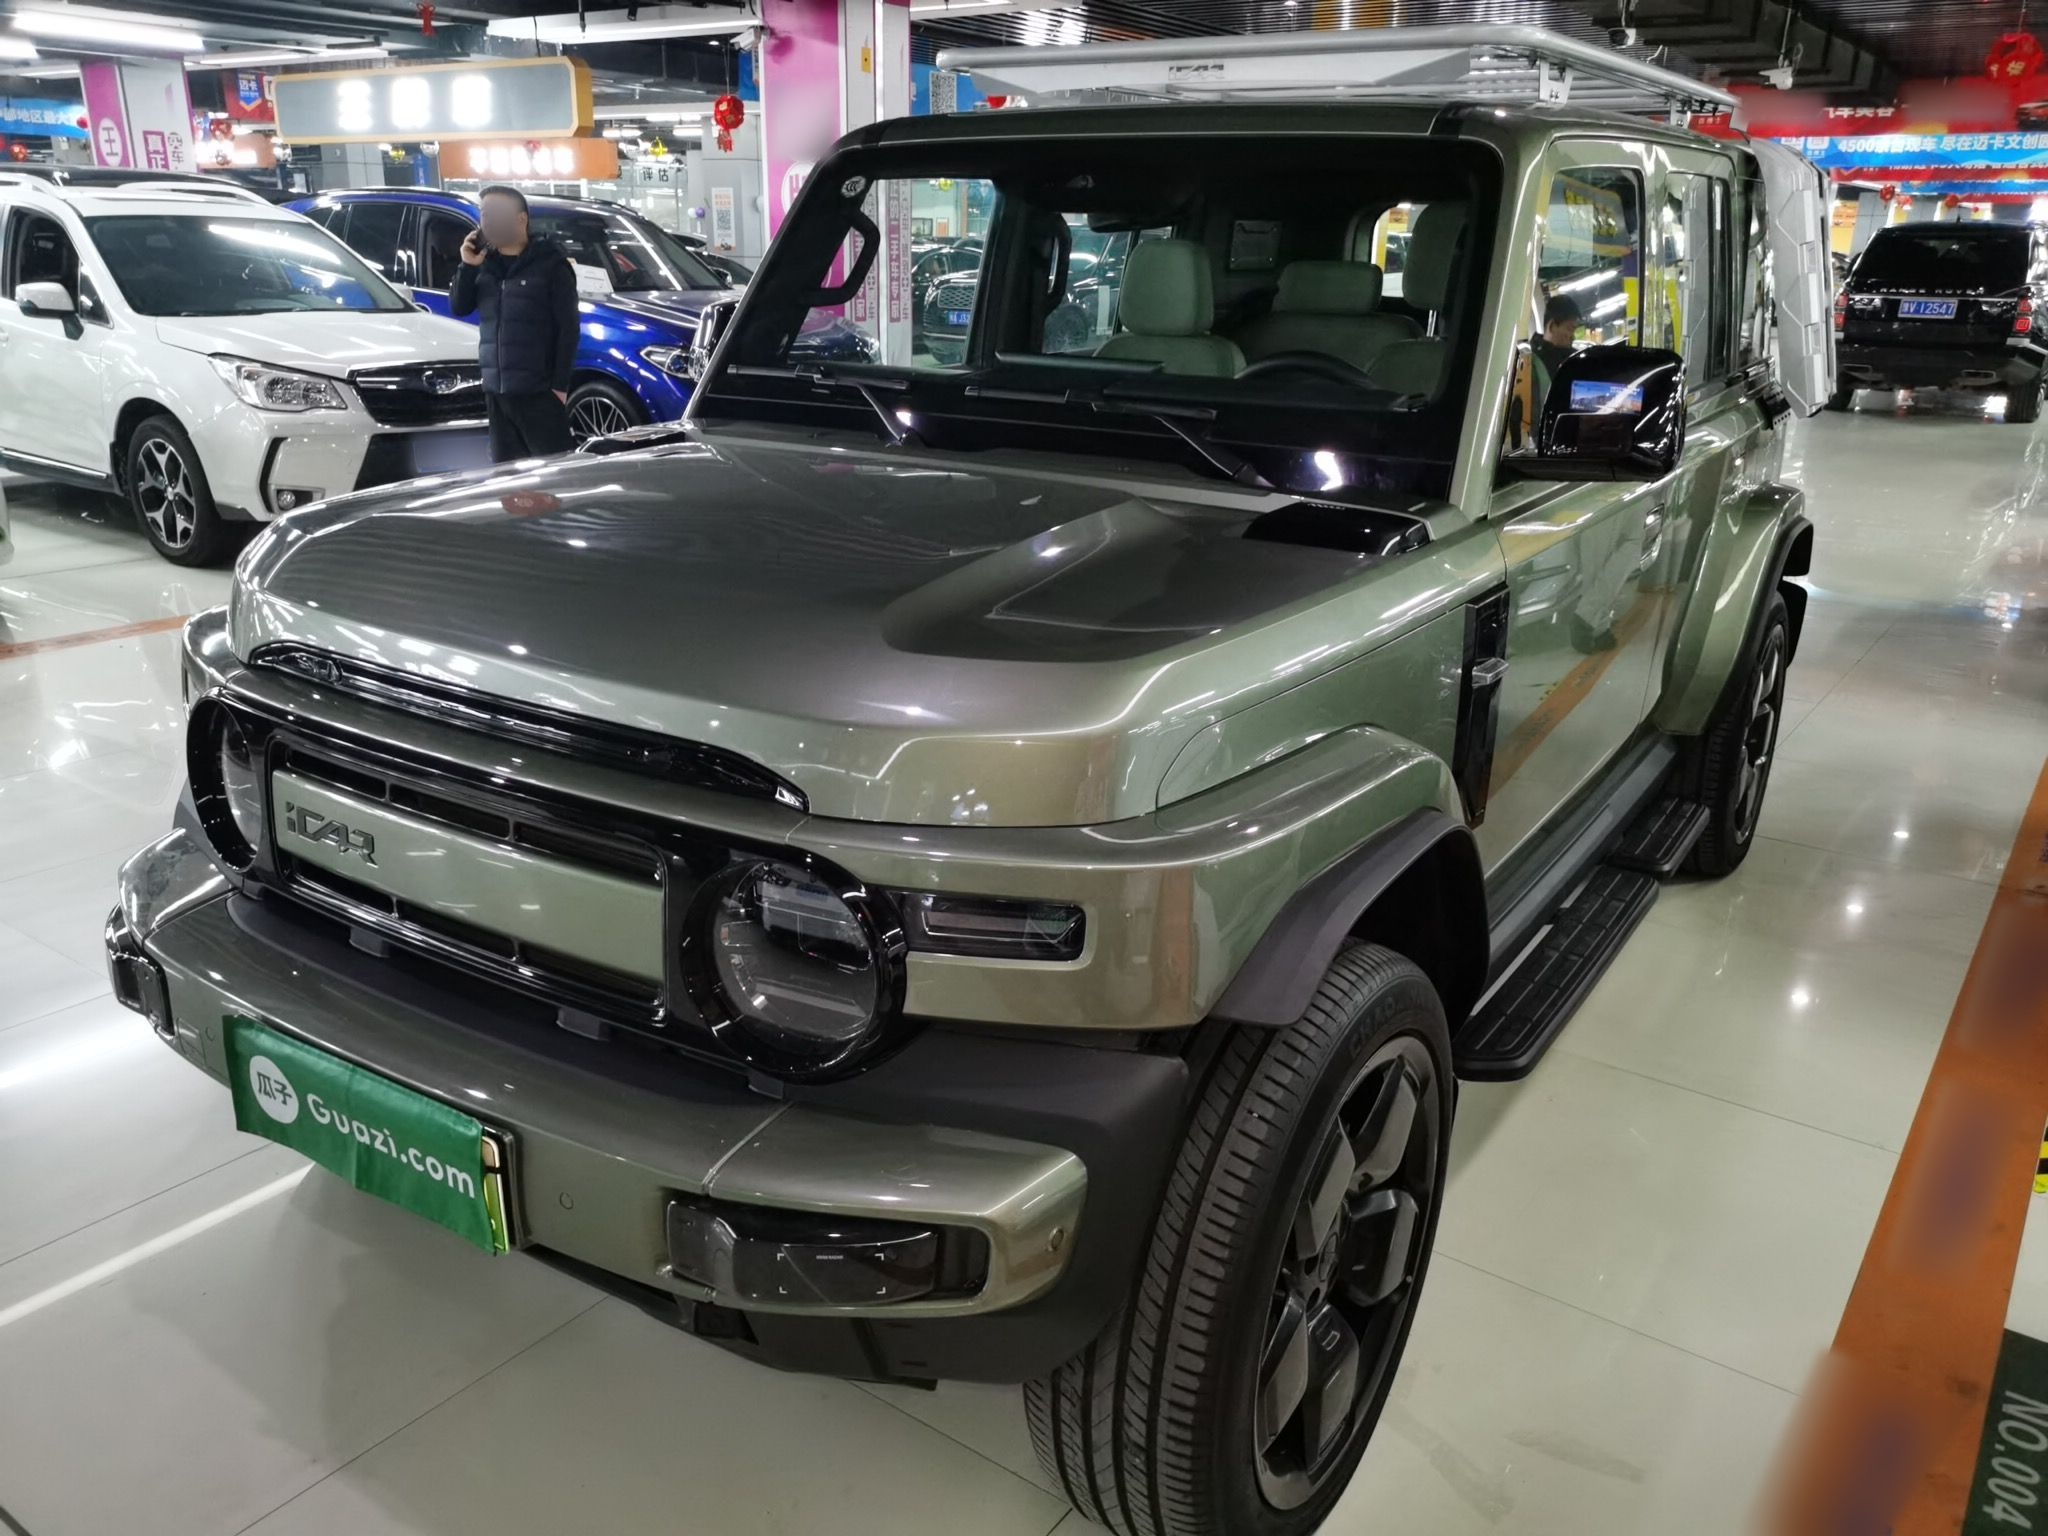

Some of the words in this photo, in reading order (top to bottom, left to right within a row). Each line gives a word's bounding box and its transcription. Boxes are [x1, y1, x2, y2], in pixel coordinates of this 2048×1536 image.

[256, 1071, 293, 1106] 瓜子
[306, 1092, 475, 1199] Guazi.com
[1983, 1391, 2048, 1529] NO.004
